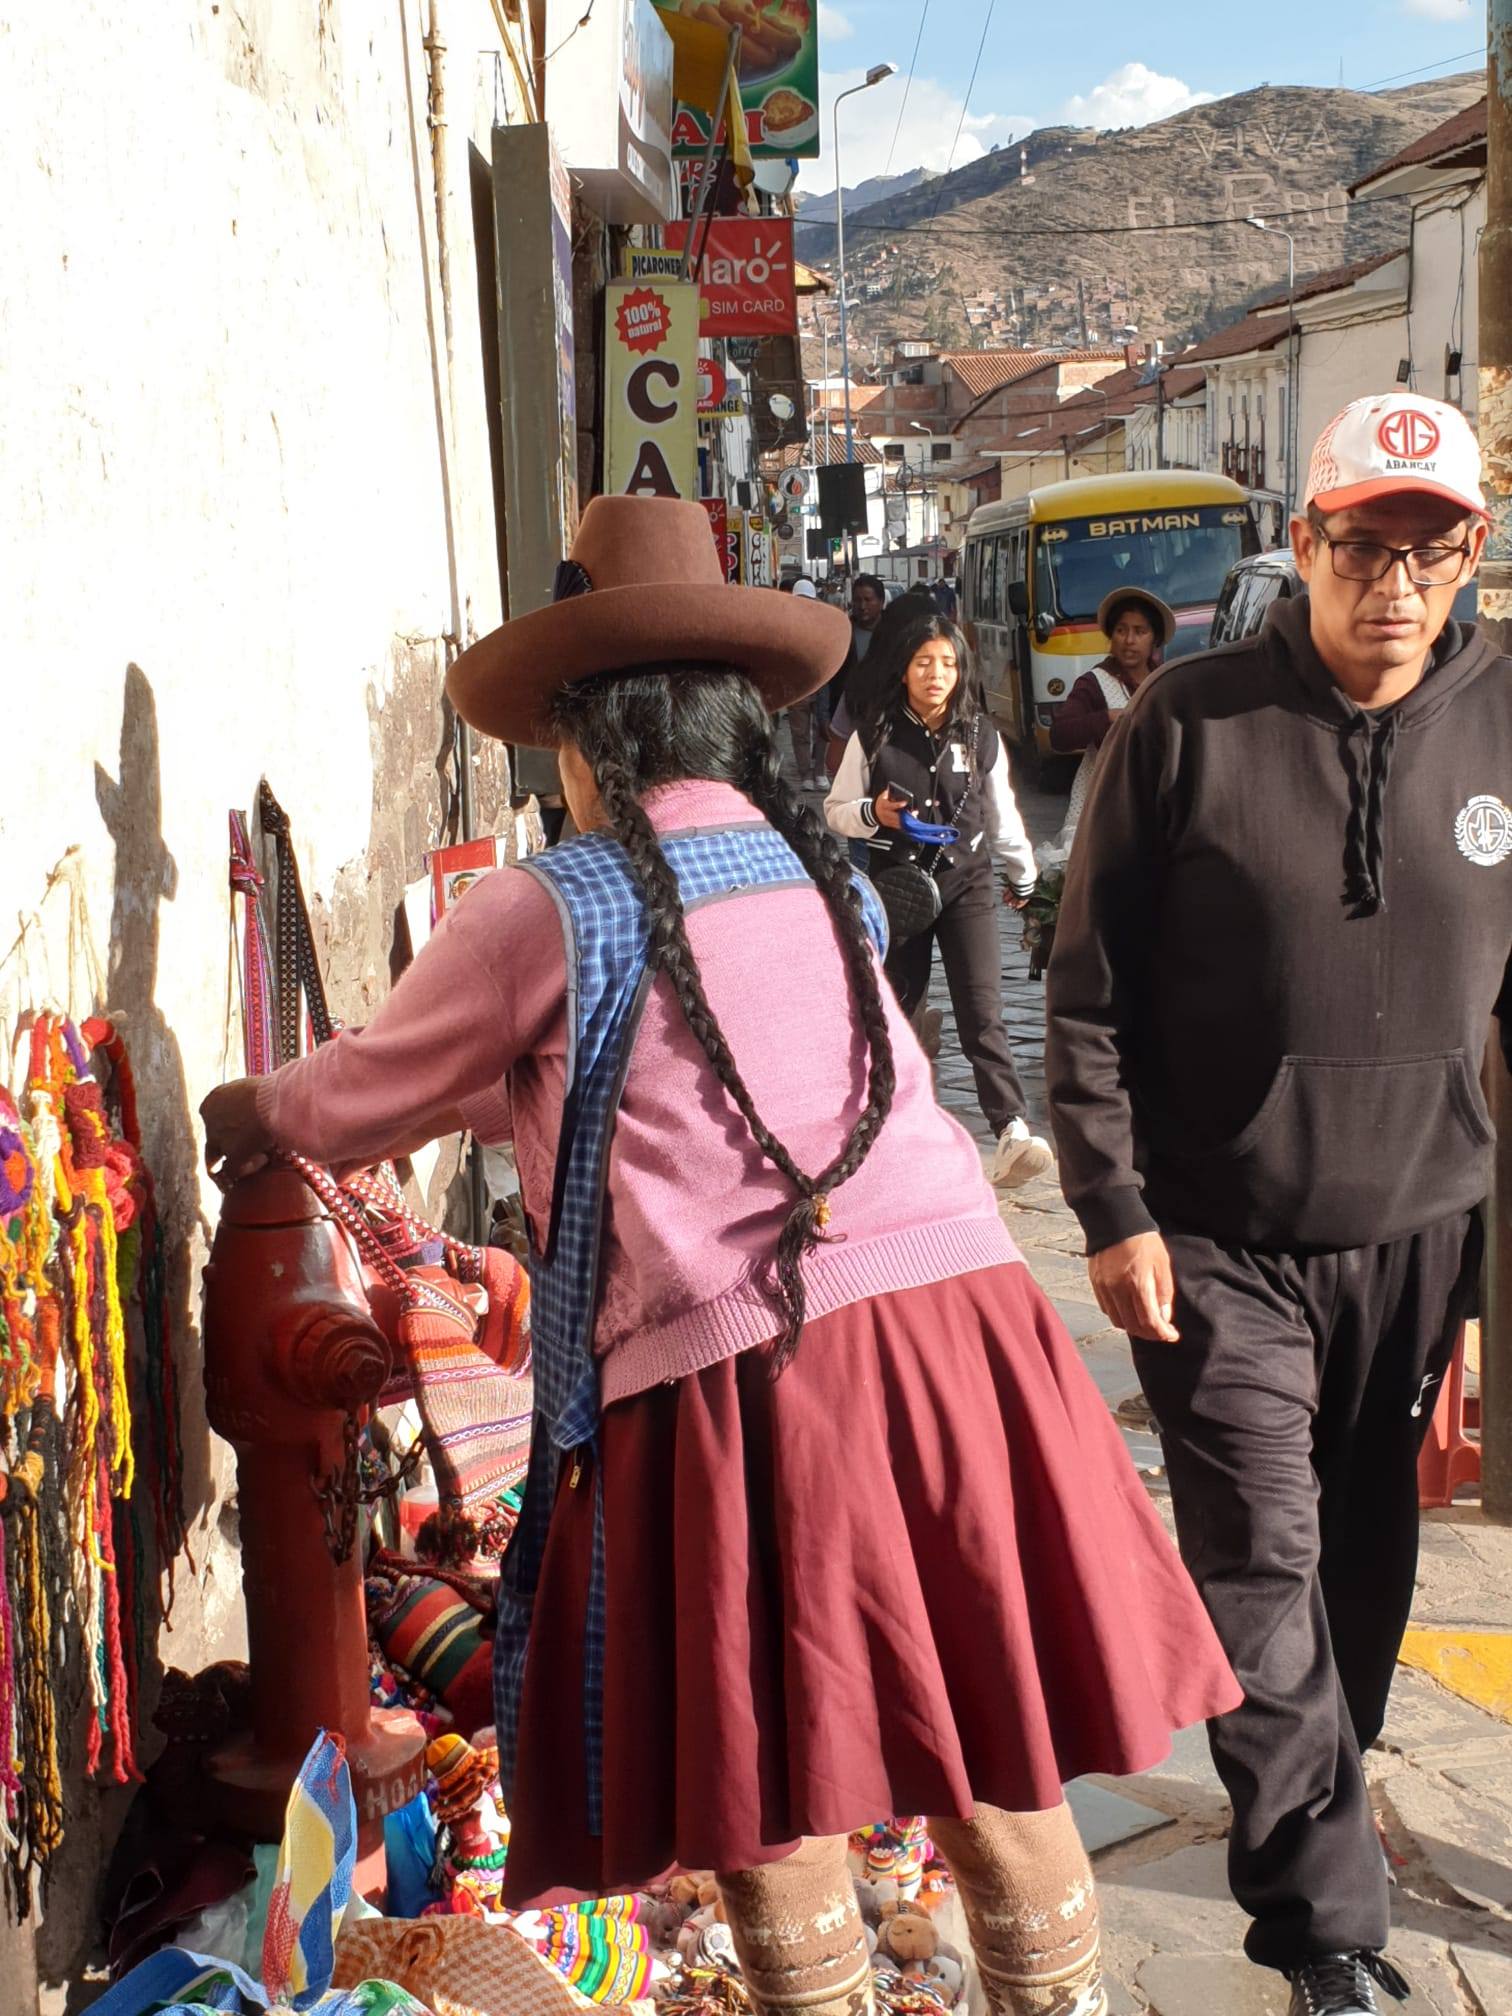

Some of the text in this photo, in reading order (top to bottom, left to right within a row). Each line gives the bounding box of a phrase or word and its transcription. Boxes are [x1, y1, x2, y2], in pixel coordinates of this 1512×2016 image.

[690, 253, 770, 285] laro
[624, 300, 661, 325] 100%
[712, 299, 785, 314] SIM CARD
[628, 318, 662, 338] natural
[1382, 412, 1436, 457] MG
[1385, 459, 1437, 472] ABANCAY
[1089, 513, 1200, 537] BATMAN
